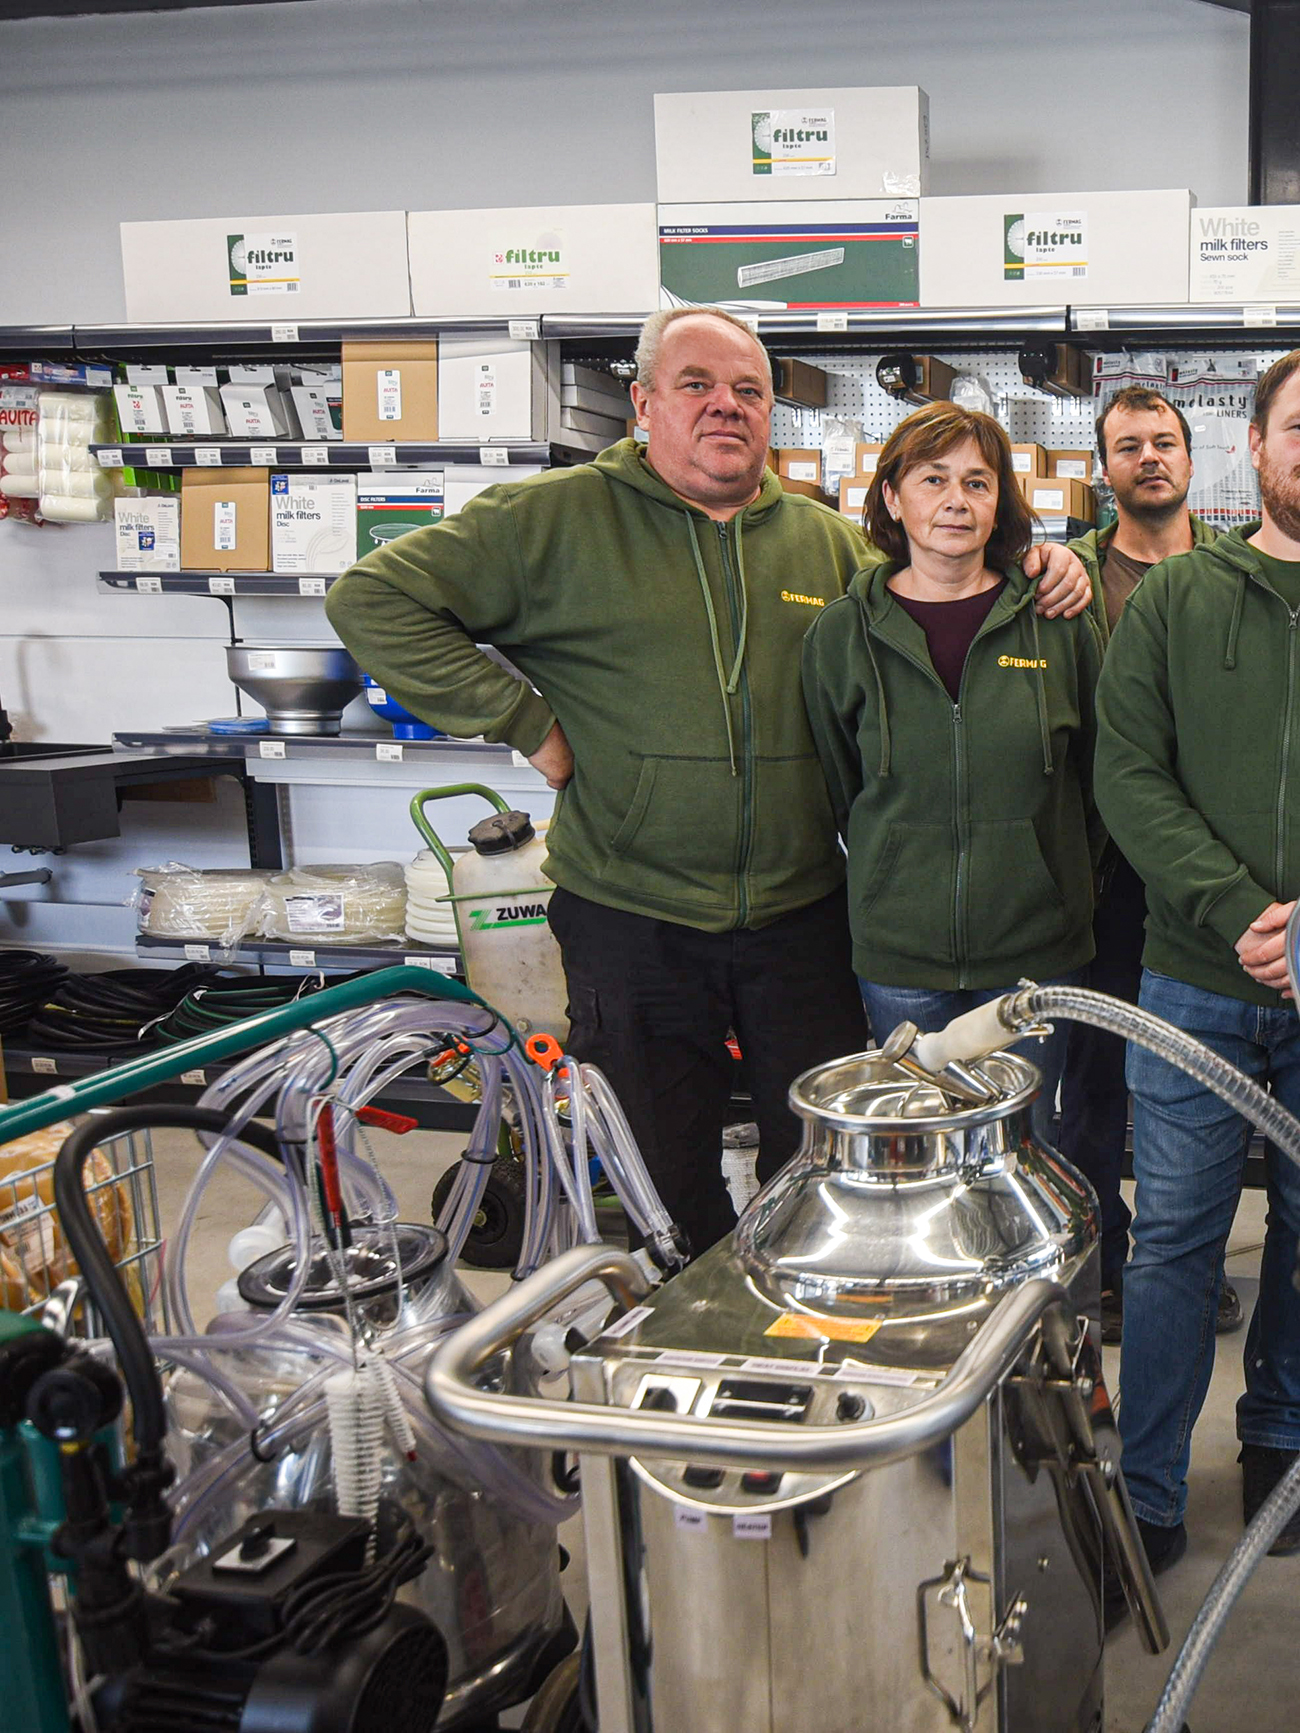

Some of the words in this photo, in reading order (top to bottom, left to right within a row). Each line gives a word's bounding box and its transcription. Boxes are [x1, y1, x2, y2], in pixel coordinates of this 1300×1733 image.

[773, 129, 828, 142] filtru
[1199, 217, 1260, 237] White
[1027, 231, 1082, 246] filtru
[1200, 239, 1228, 251] milk
[1230, 238, 1268, 251] filters
[247, 250, 294, 264] filtru
[505, 249, 560, 263] filtru
[1200, 253, 1225, 262] Sewn
[1227, 252, 1249, 261] sock
[1216, 410, 1248, 419] LINERS
[275, 496, 315, 510] White
[118, 512, 150, 524] White
[276, 511, 295, 520] milk
[296, 511, 321, 520] filters
[790, 593, 825, 607] FERMAG
[496, 904, 547, 921] ZUWA
